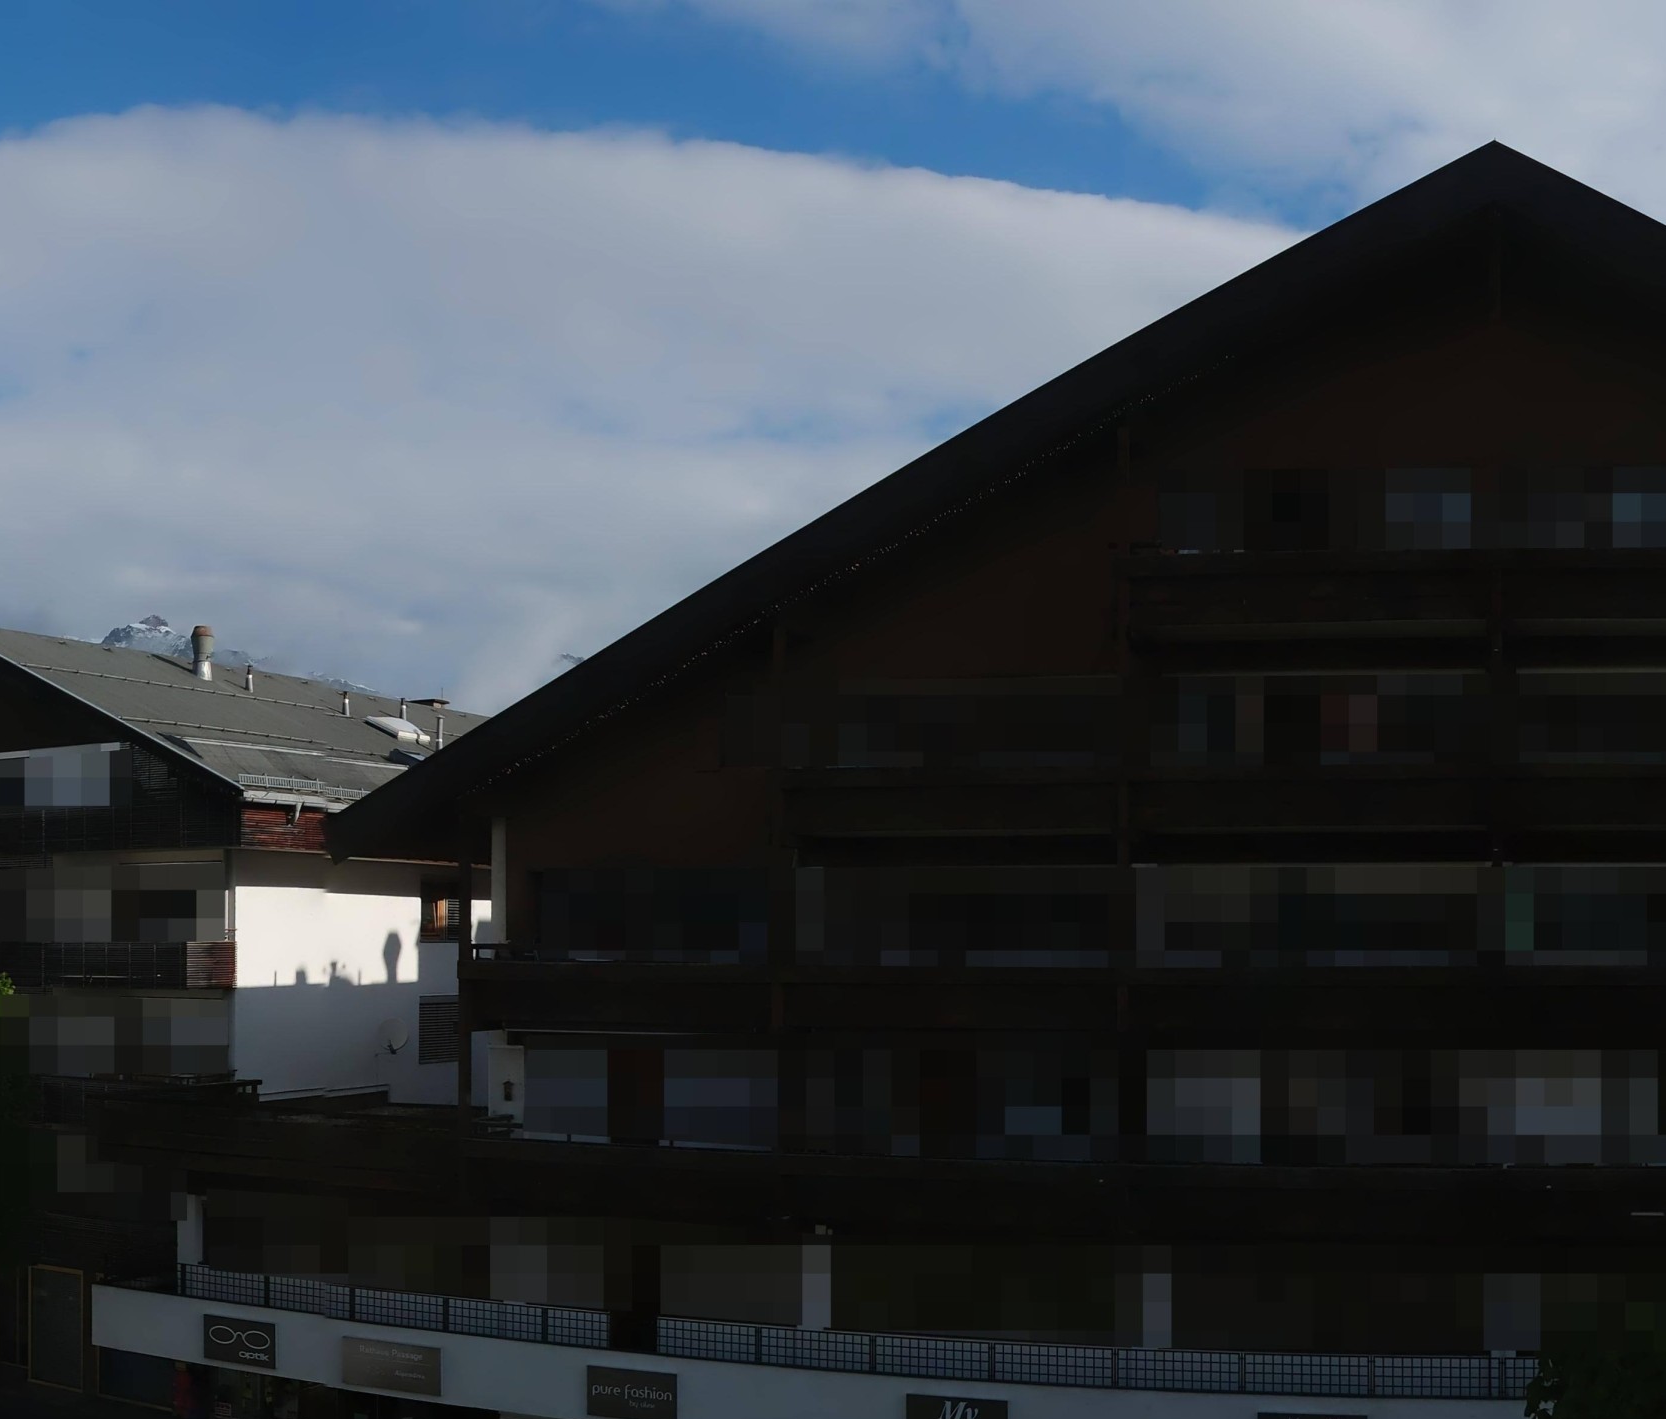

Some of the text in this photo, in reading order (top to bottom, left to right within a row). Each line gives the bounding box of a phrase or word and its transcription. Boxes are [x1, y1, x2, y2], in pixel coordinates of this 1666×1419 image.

[238, 1351, 270, 1362] optik
[391, 1348, 423, 1361] Passage
[592, 1383, 673, 1401] pure fashion
